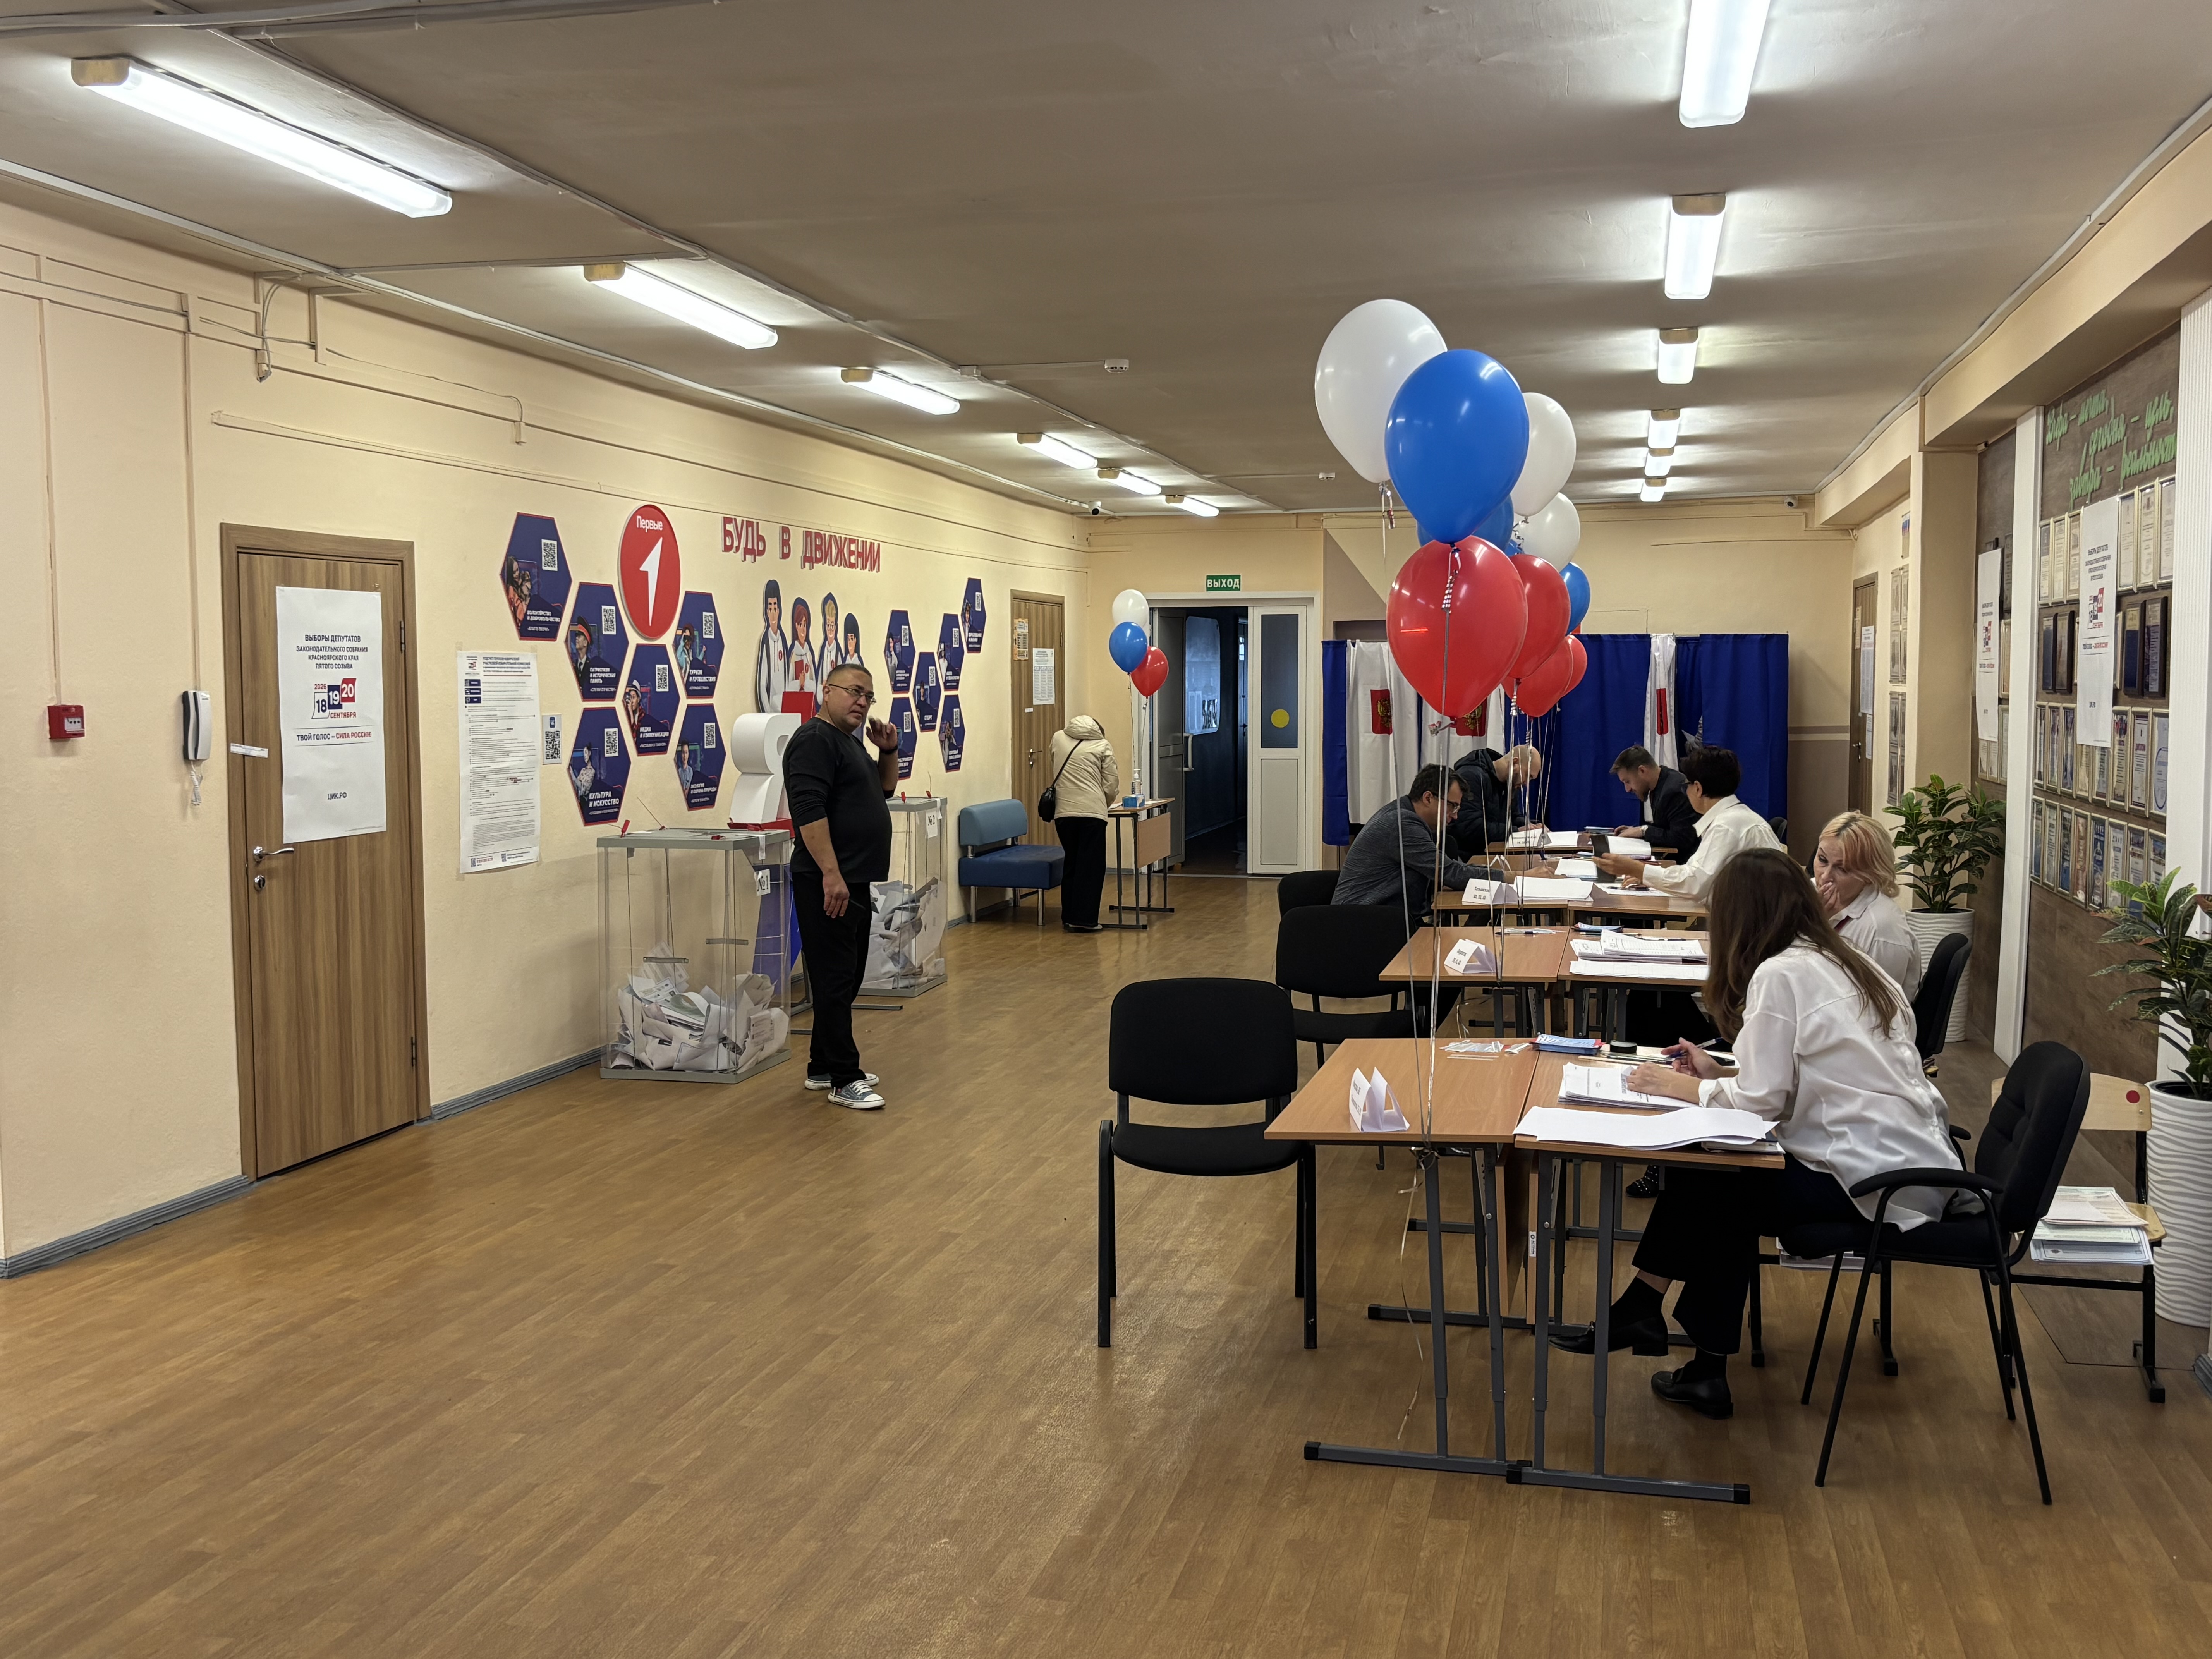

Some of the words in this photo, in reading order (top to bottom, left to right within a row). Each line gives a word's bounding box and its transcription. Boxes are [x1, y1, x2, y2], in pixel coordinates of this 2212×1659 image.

[637, 515, 663, 532] Первые
[722, 516, 766, 563] БУДЬ
[780, 526, 791, 559] В
[801, 530, 880, 573] ДВИЖЕНИИ
[1207, 579, 1240, 589] ВЫХОД
[316, 699, 327, 713] 18
[329, 690, 340, 705] 19
[342, 684, 354, 697] 20
[297, 733, 312, 741] ТВОЙ
[589, 791, 611, 799] КУЛЬТУРА
[593, 798, 619, 807] ИСКУССТВО
